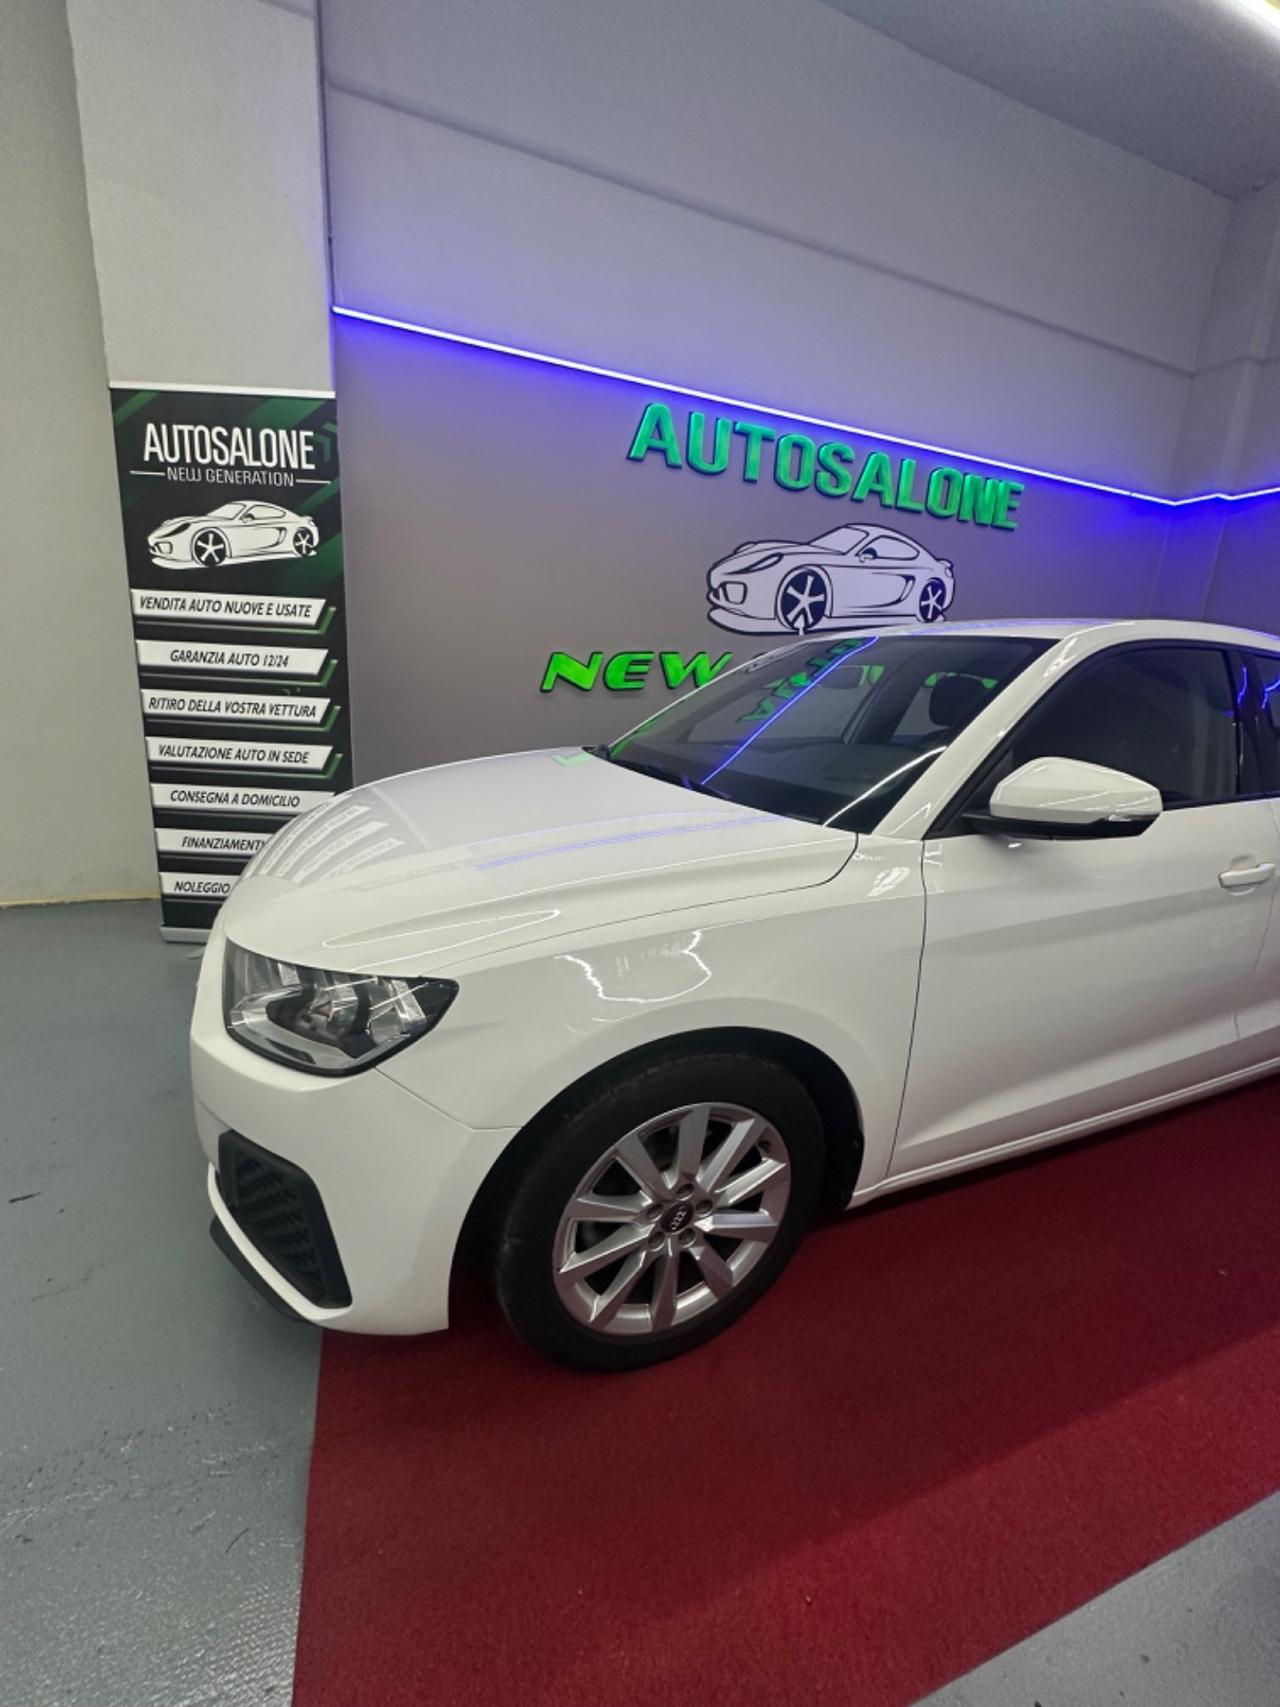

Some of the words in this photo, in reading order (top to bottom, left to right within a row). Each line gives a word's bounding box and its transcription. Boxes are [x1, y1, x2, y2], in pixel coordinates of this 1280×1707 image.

[143, 423, 316, 470] AUTOSALONE
[167, 466, 202, 482] NEW
[205, 469, 295, 487] GENERATION
[627, 403, 1025, 531] AUTOSALONE
[139, 596, 187, 612] VENDITA
[188, 600, 222, 614] AUTO
[224, 601, 264, 615] NUOVE
[265, 604, 273, 616] E
[274, 605, 313, 618] USATE
[170, 649, 225, 665] GARANZIA
[227, 653, 260, 666] AUTO
[540, 651, 732, 693] NEW
[148, 697, 186, 712] RITIRO
[187, 699, 222, 713] DELLA
[223, 702, 267, 716] VOSTRA
[268, 704, 317, 718] VETTURA
[158, 744, 231, 760] VALUTAZIONE
[233, 748, 266, 762] AUTO
[267, 750, 281, 763] IN
[282, 751, 310, 764] SEDE
[170, 790, 228, 804] CONSEGNA
[230, 794, 239, 805] A
[241, 793, 301, 808] DOMICILIO
[174, 881, 231, 894] NOLEGGIO
